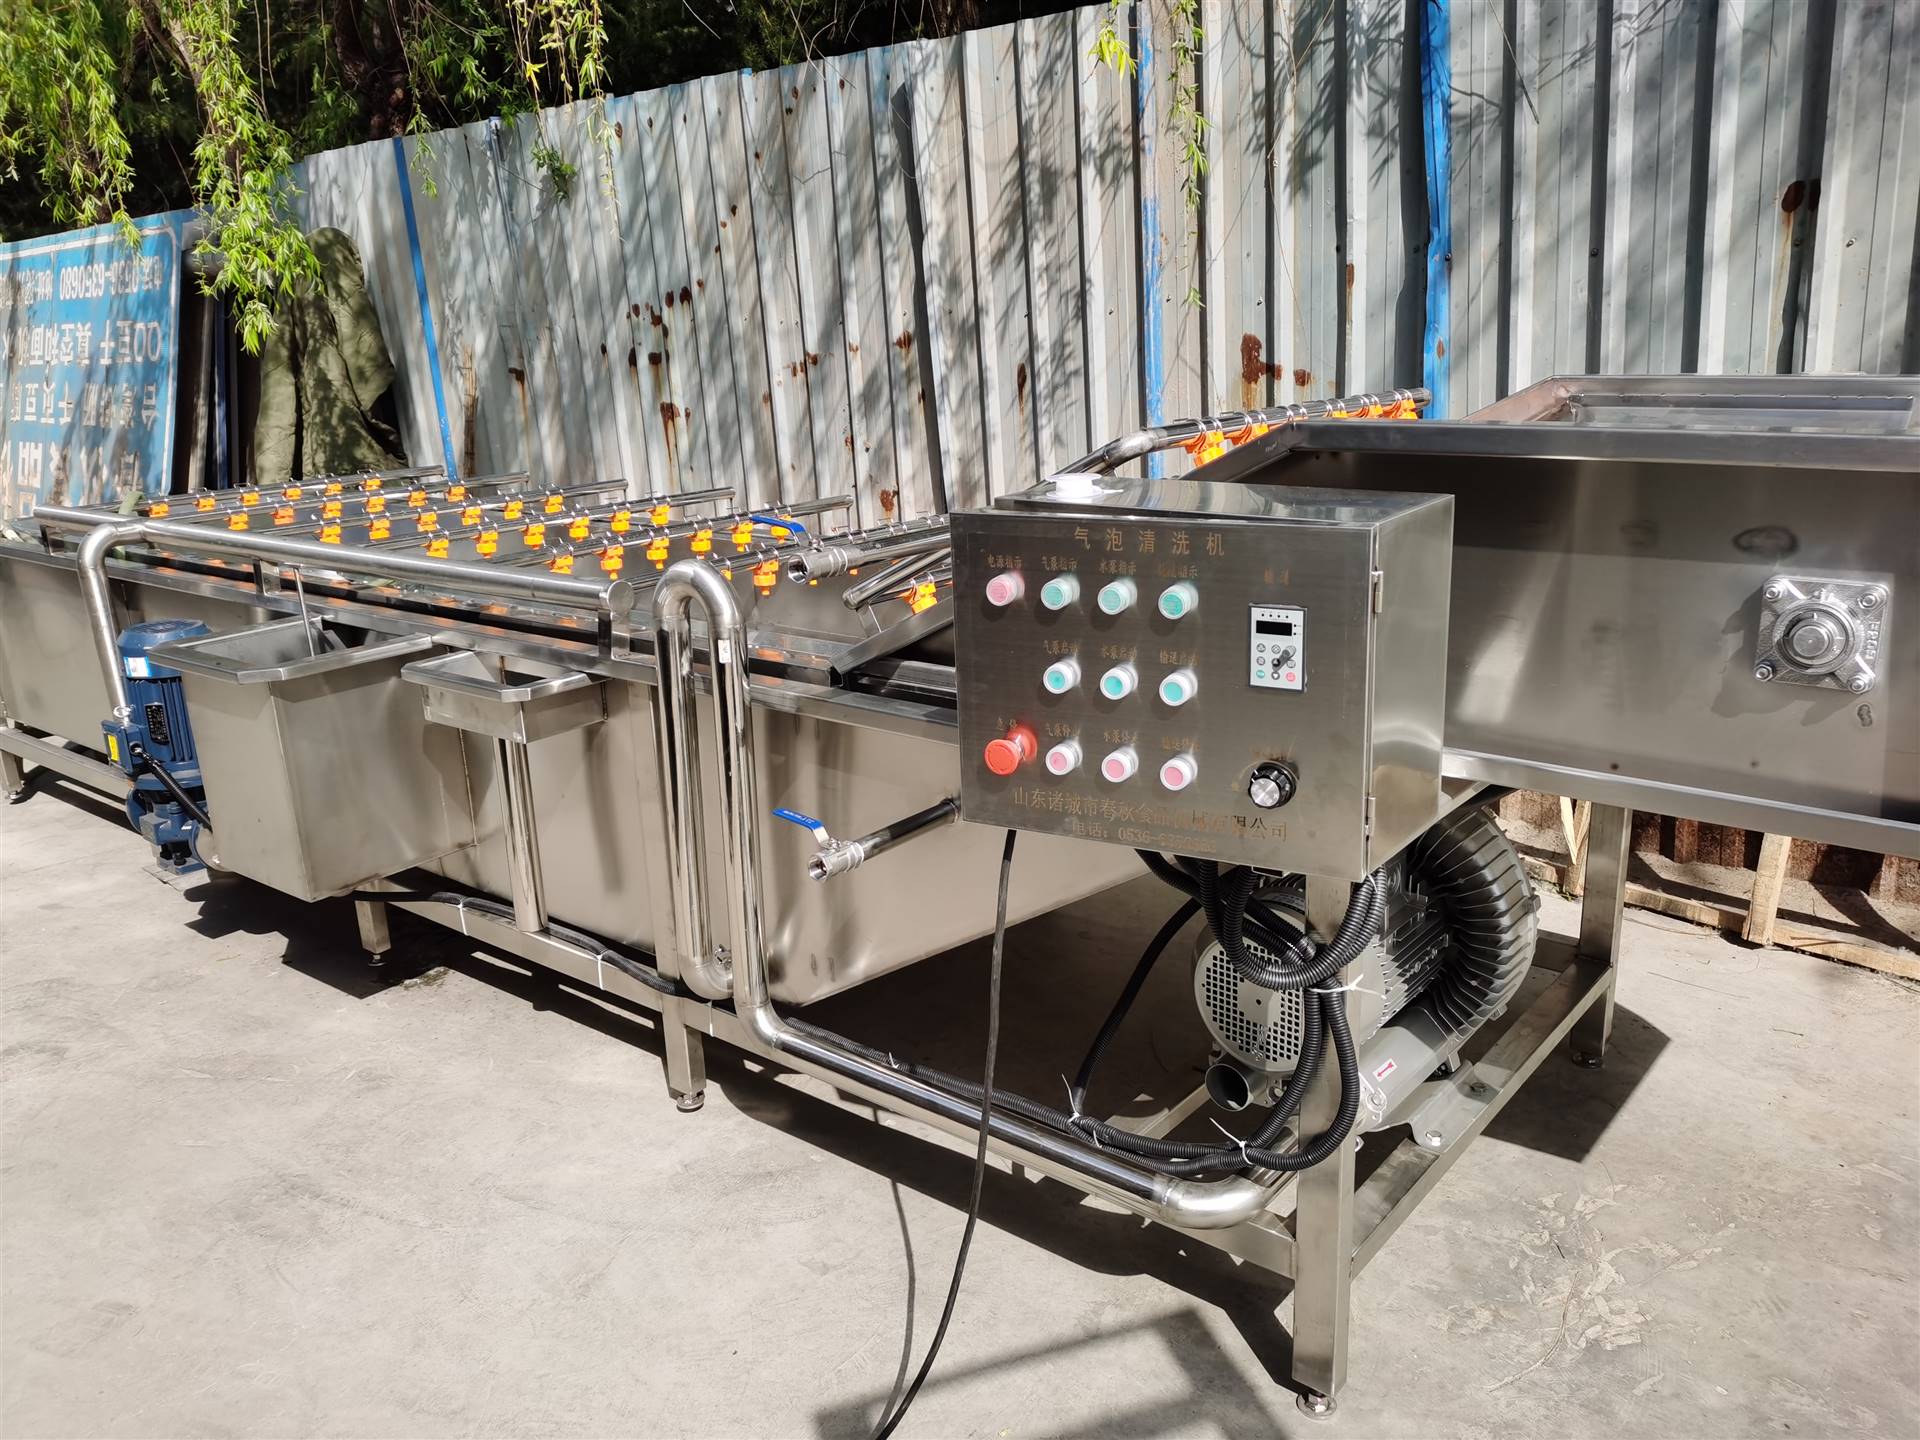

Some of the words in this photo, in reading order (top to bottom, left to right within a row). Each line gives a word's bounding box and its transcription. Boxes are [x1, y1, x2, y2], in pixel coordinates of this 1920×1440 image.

[1074, 526, 1224, 556] 气泡清洗机
